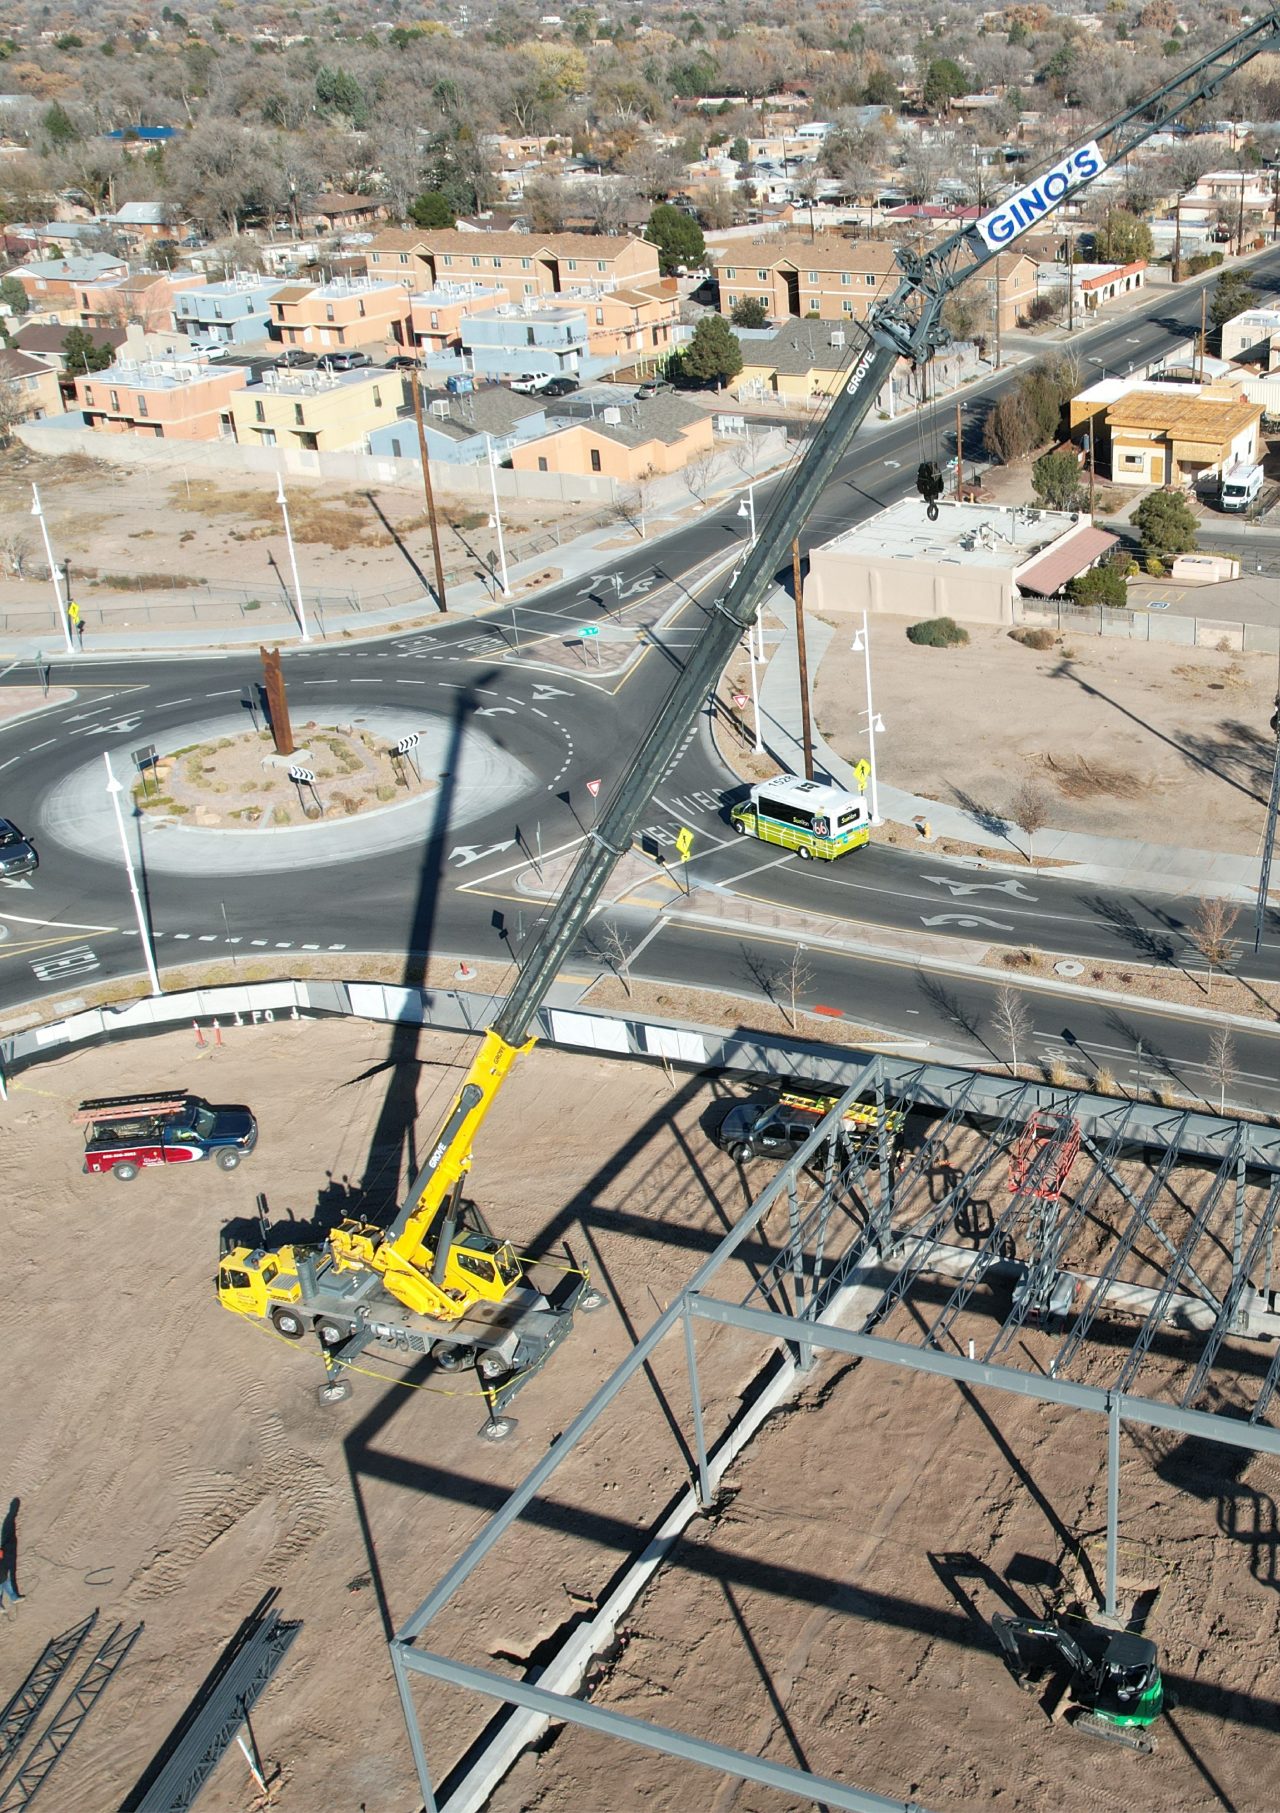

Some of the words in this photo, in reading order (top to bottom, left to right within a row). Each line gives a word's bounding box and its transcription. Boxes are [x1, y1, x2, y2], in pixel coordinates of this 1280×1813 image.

[987, 149, 1099, 243] GINO'S
[846, 350, 877, 395] GROVE
[428, 1142, 447, 1169] GROVE
